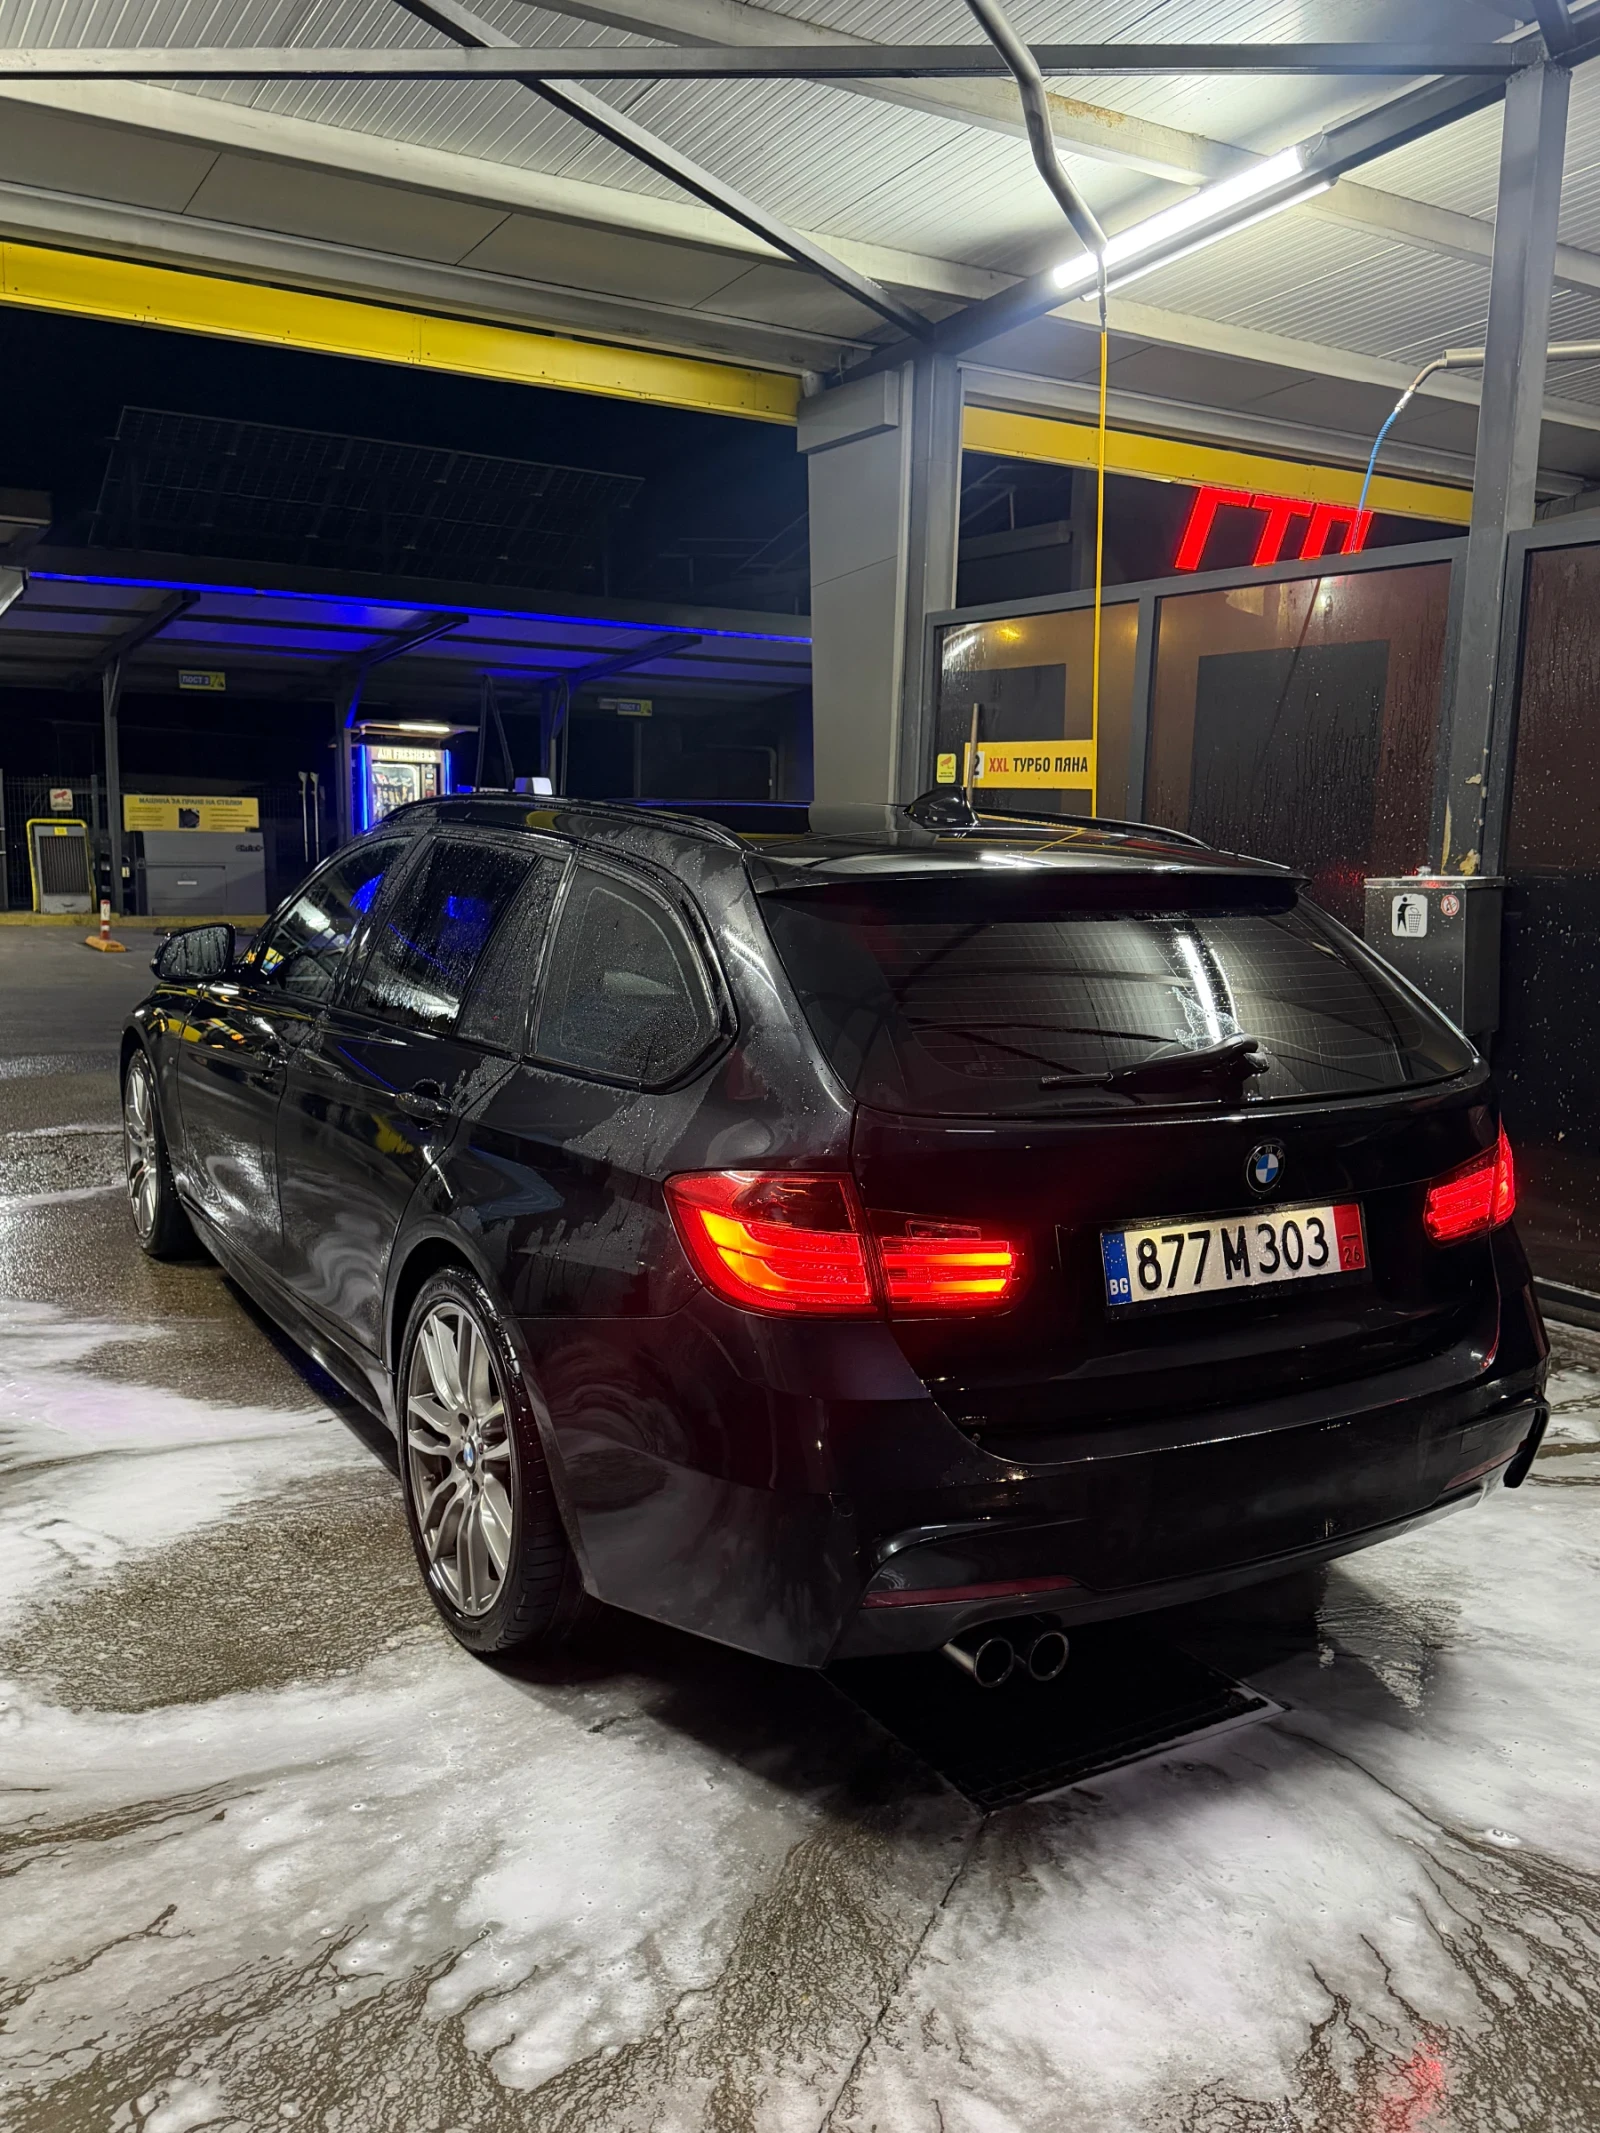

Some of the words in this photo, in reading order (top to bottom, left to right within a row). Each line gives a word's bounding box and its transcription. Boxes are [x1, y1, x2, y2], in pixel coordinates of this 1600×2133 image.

[1174, 485, 1374, 571] ГТП
[182, 675, 203, 685] ПОСТ
[989, 757, 1009, 772] XXL
[1013, 757, 1051, 772] ТУРБО
[1054, 756, 1088, 772] ПЯНА
[138, 797, 171, 805] МАШИНА
[1252, 1144, 1285, 1162] BMW
[1109, 1277, 1129, 1296] BG
[1137, 1229, 1211, 1292] 877
[1257, 1216, 1330, 1275] 303
[1342, 1245, 1362, 1265] 26
